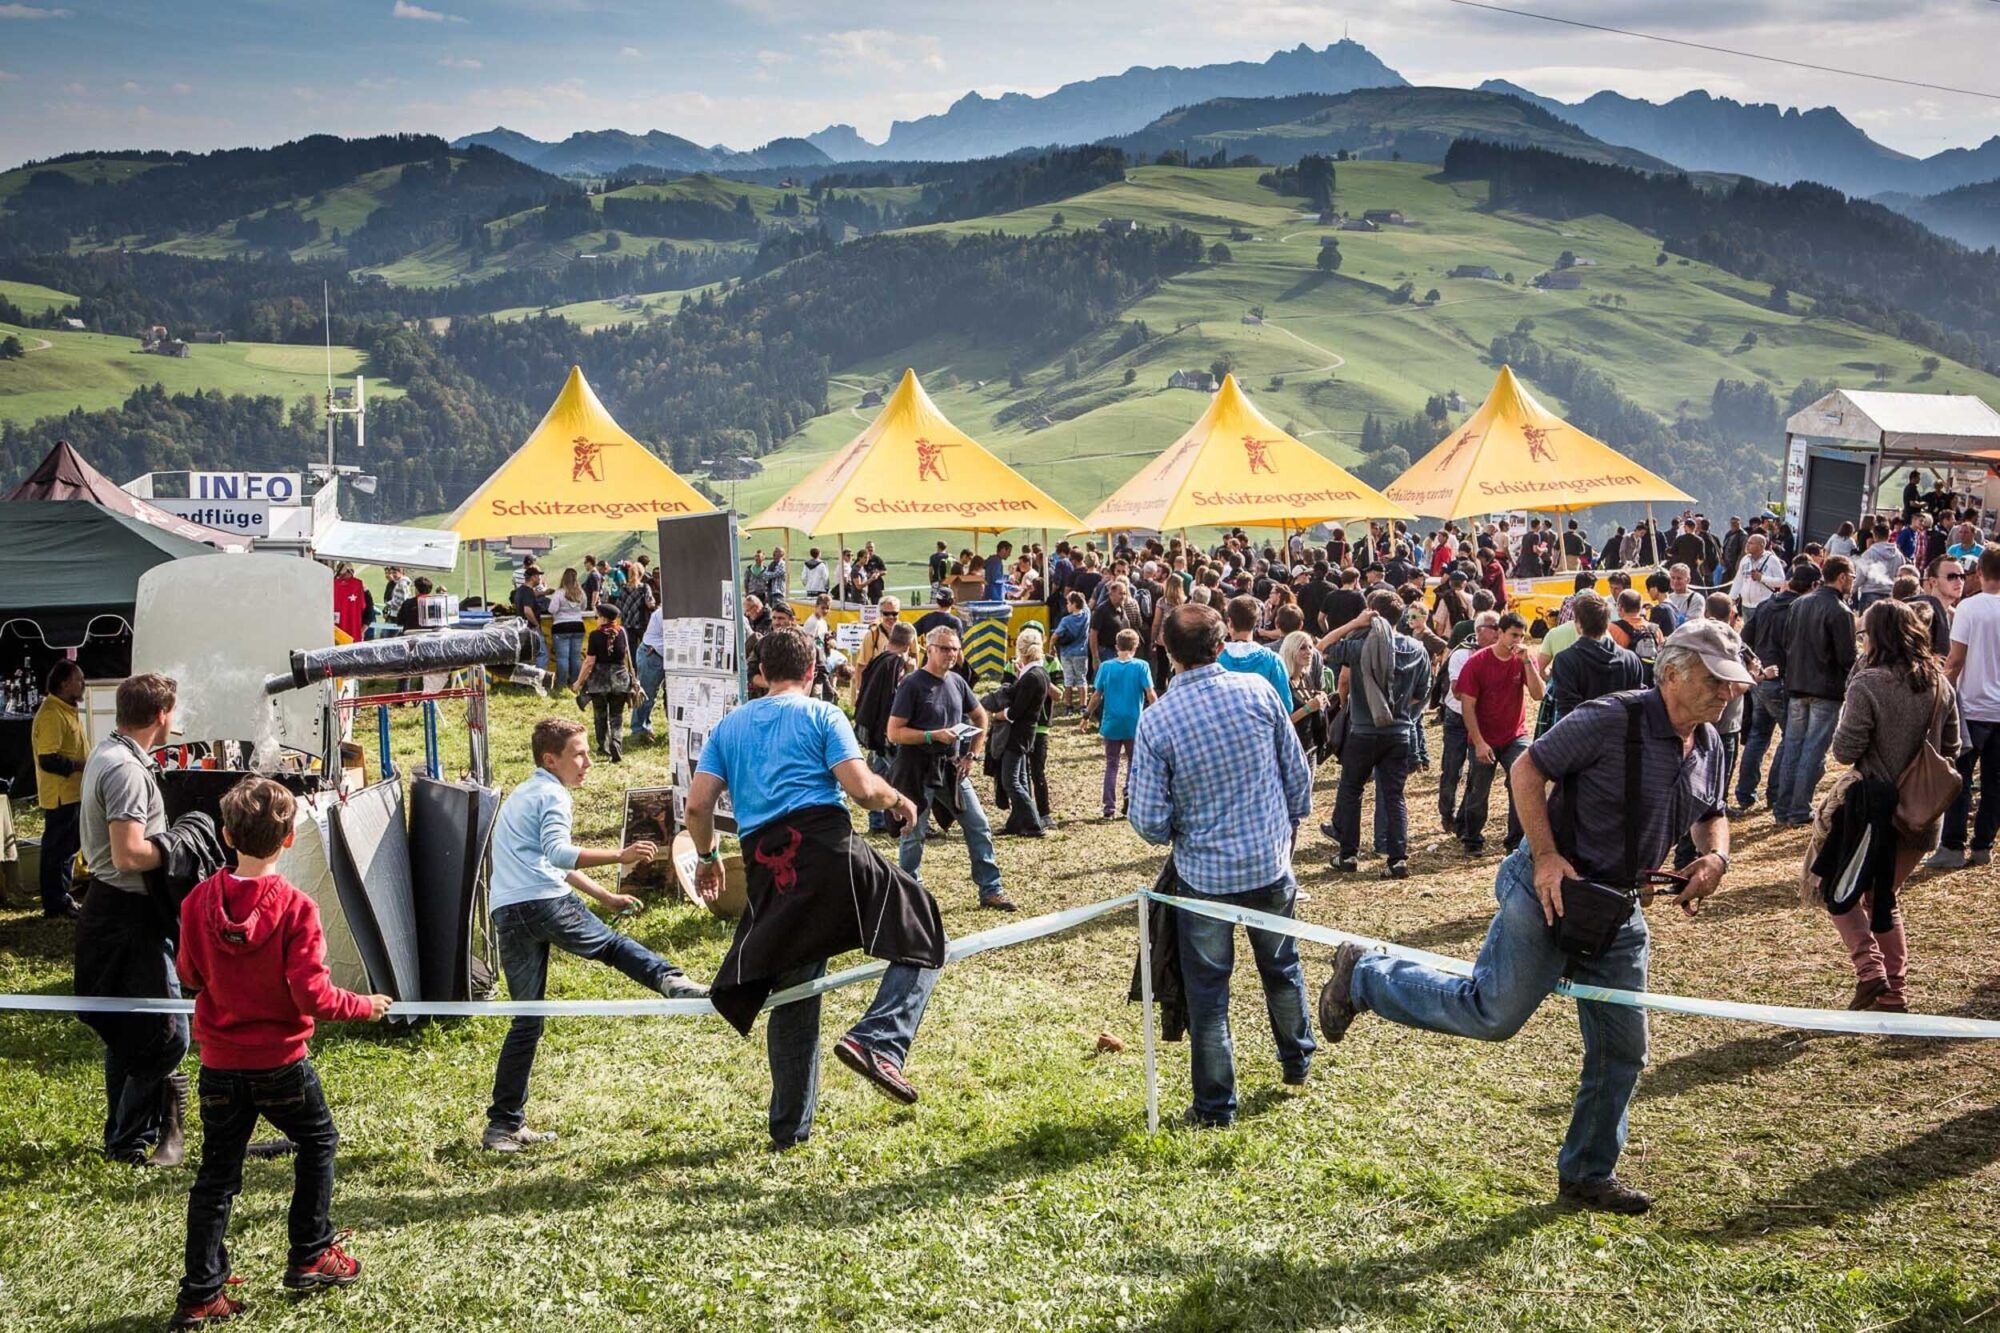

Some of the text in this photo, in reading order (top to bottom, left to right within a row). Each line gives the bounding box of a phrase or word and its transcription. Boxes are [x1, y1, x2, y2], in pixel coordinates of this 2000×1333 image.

[199, 475, 293, 502] INFO
[1478, 473, 1642, 494] Schützengarten
[854, 497, 1038, 518] Schützengarten
[1190, 488, 1362, 508] Schützengarten
[176, 508, 263, 528] ndflüge
[492, 499, 691, 520] Schützengarten
